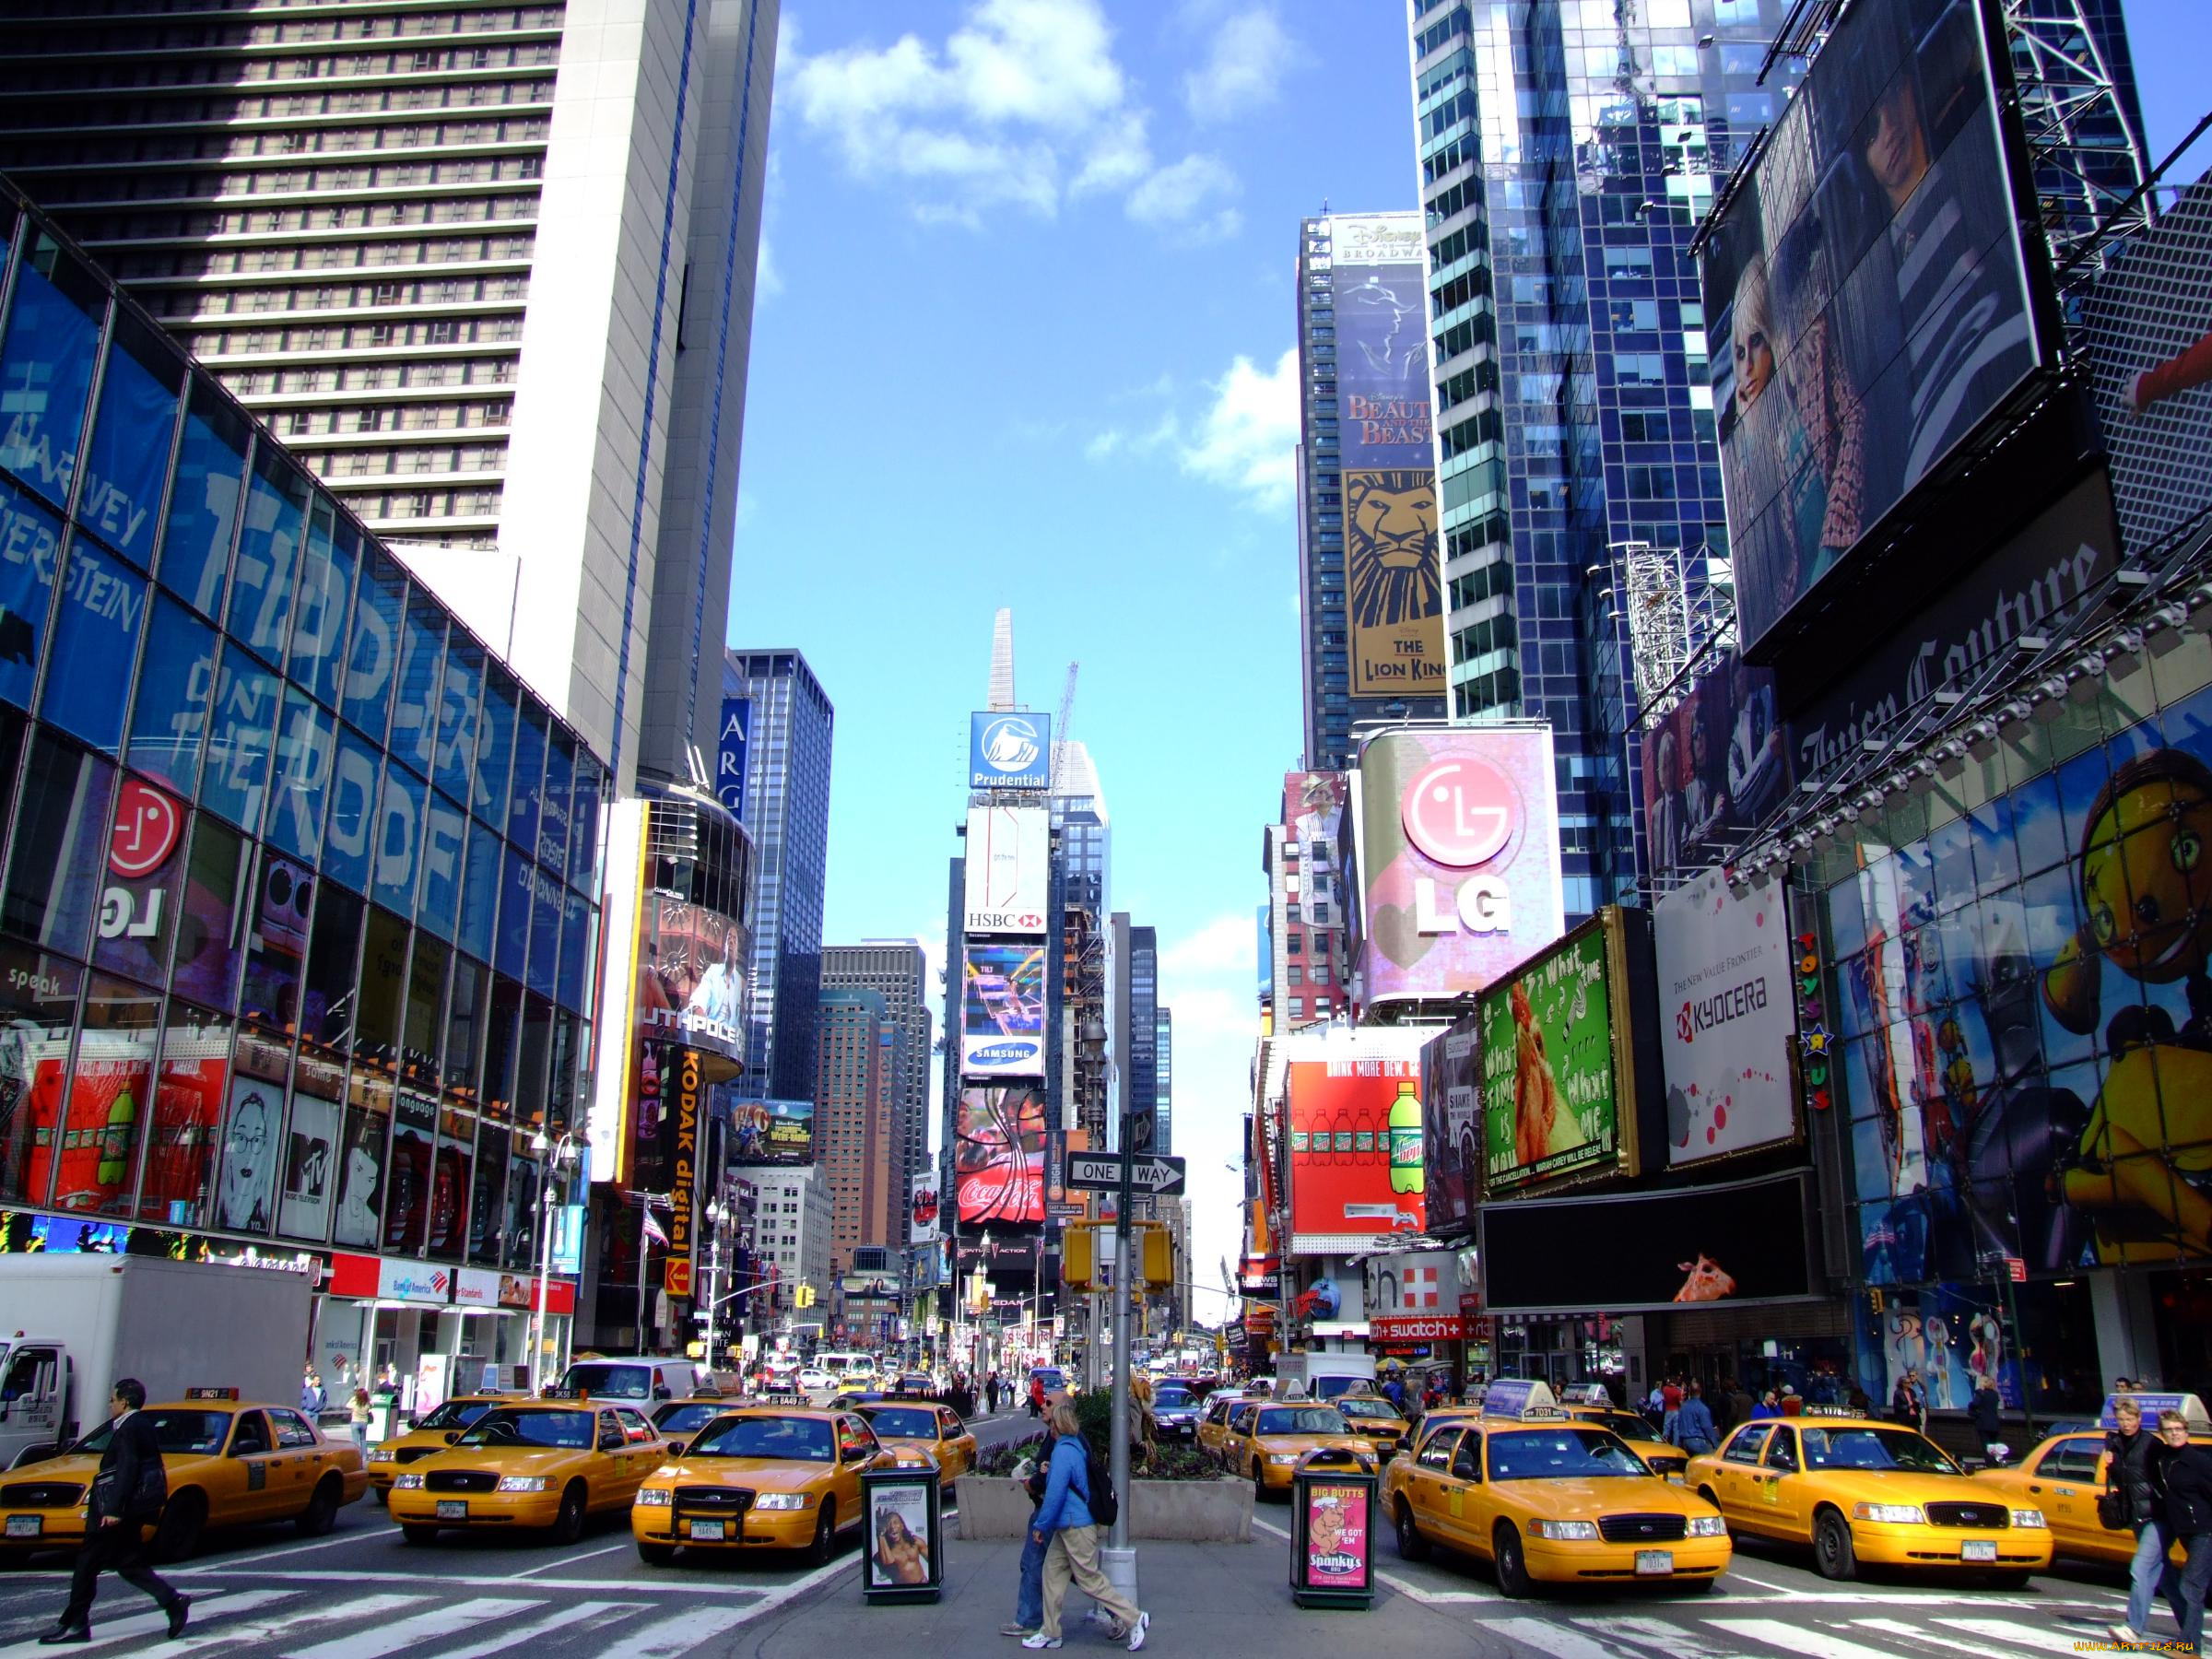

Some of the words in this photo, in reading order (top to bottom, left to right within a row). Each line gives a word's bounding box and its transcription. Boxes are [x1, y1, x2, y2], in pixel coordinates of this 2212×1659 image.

[1393, 640, 1424, 653] THE
[1365, 659, 1406, 682] LION
[973, 772, 1045, 787] Prudential
[265, 709, 462, 913] ROOF
[1415, 875, 1512, 936] LG
[969, 912, 1016, 928] HSBC
[980, 965, 994, 973] TILT
[1674, 981, 1688, 994] THE
[1687, 971, 1702, 987] NEW
[1703, 961, 1725, 980] VALUE
[1726, 945, 1763, 971] FRONTIER
[8, 968, 60, 996] speak
[975, 1048, 1031, 1059] SAMSUNG
[305, 1065, 332, 1085] same
[1357, 1061, 1381, 1077] MORE
[1384, 1061, 1405, 1077] DEW.
[677, 1049, 699, 1151] KODAK
[286, 1131, 333, 1197] MTV
[1553, 1155, 1567, 1169] CAREY
[1577, 1149, 1584, 1160] BE
[1083, 1163, 1115, 1180] ONE
[1137, 1166, 1171, 1182] WAY
[672, 1157, 693, 1251] digital
[1390, 1321, 1447, 1337] swatch
[200, 1389, 219, 1398] 9N21
[1311, 1488, 1329, 1497] BIG
[1331, 1488, 1365, 1499] BUTTS
[1334, 1528, 1347, 1536] WE
[1347, 1529, 1363, 1537] GOT
[1310, 1554, 1362, 1569] Spanky's
